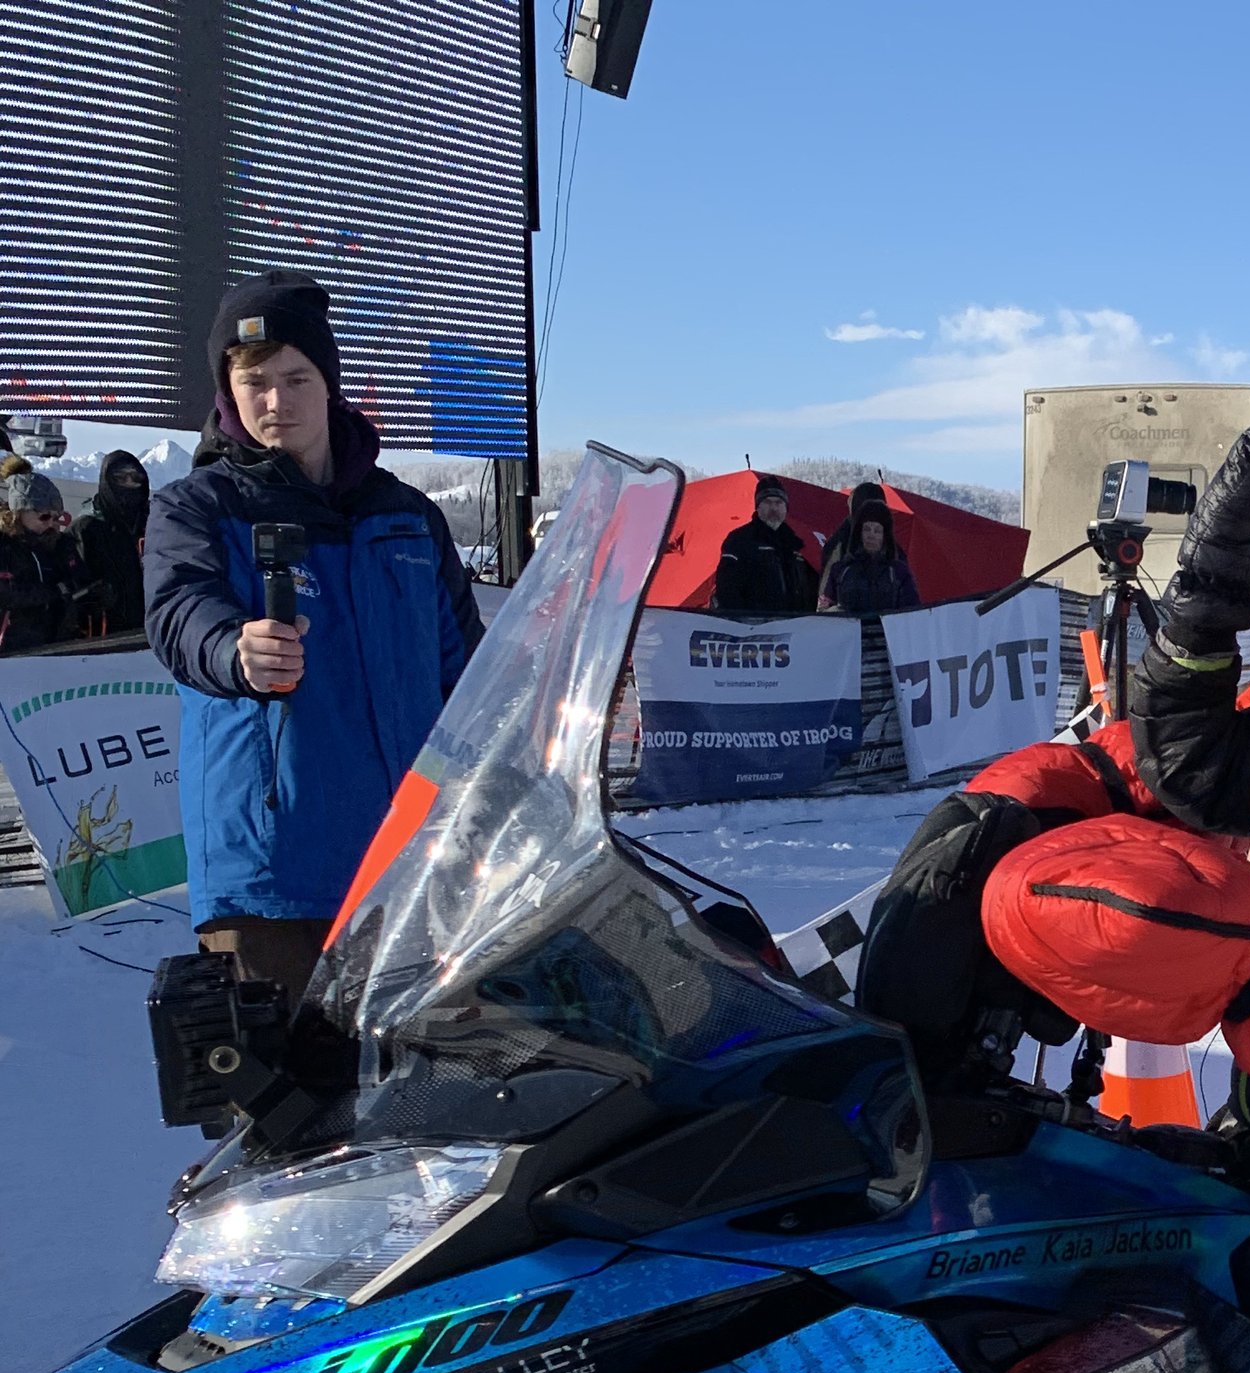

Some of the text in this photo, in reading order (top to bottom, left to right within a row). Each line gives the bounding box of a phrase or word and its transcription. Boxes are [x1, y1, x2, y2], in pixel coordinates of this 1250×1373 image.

[1110, 425, 1191, 441] Coachmen
[689, 633, 791, 669] EVERTS
[936, 638, 1049, 719] TOTE
[27, 724, 171, 787] LUBE
[640, 730, 688, 750] PROUD
[691, 731, 779, 749] SUPPORTER
[780, 731, 801, 747] OF
[925, 1222, 1193, 1279] Brianne Kaia Jackson
